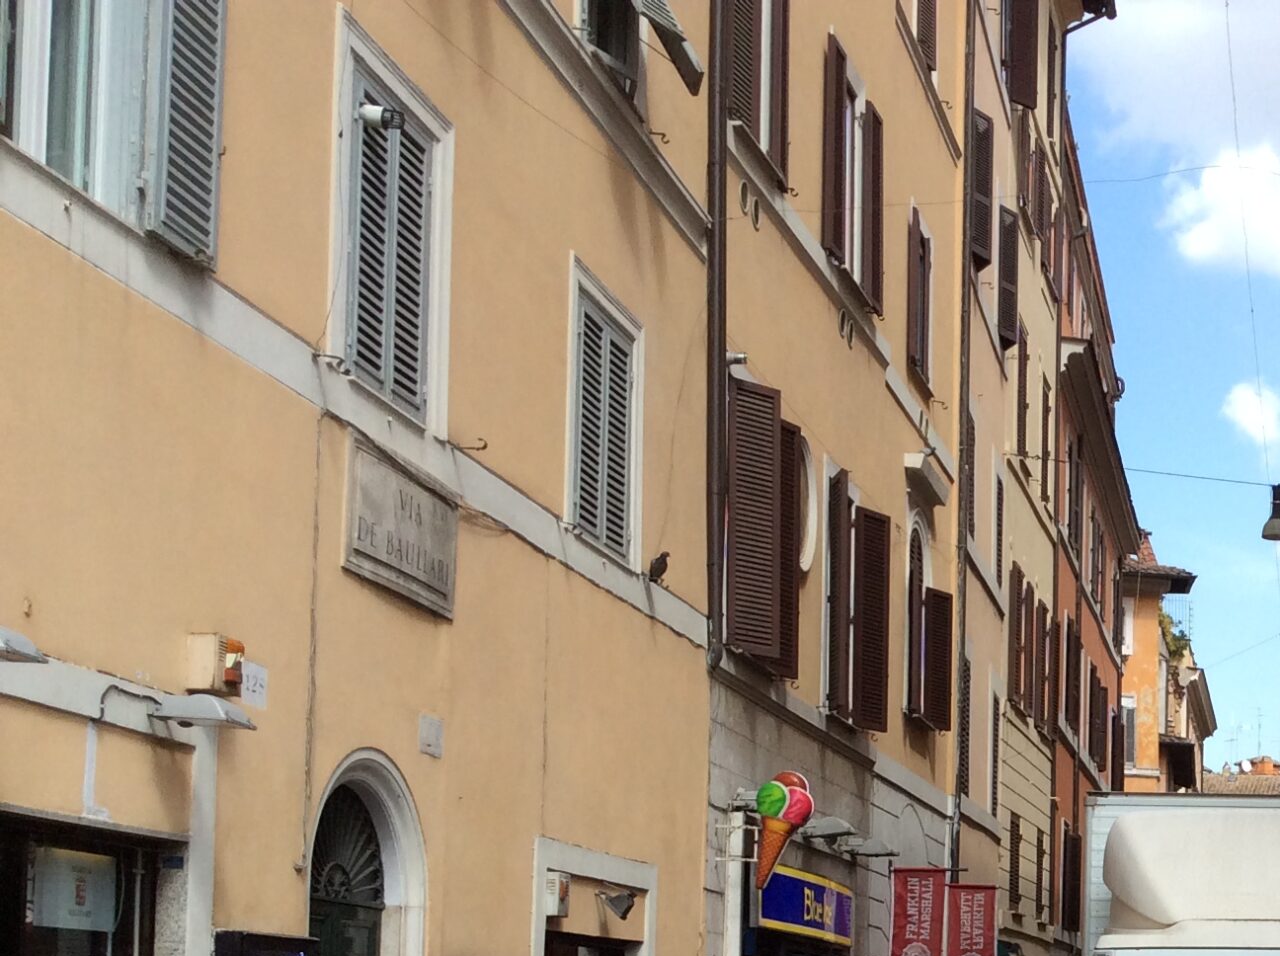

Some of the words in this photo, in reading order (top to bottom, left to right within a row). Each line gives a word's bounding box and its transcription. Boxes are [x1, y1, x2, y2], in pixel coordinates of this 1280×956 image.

[399, 488, 422, 528] VIA
[358, 515, 376, 549] DE
[386, 530, 449, 588] BAULLARI
[804, 886, 823, 922] Blue
[905, 877, 920, 939] FRANKLIN
[919, 877, 934, 940] MARSHALL
